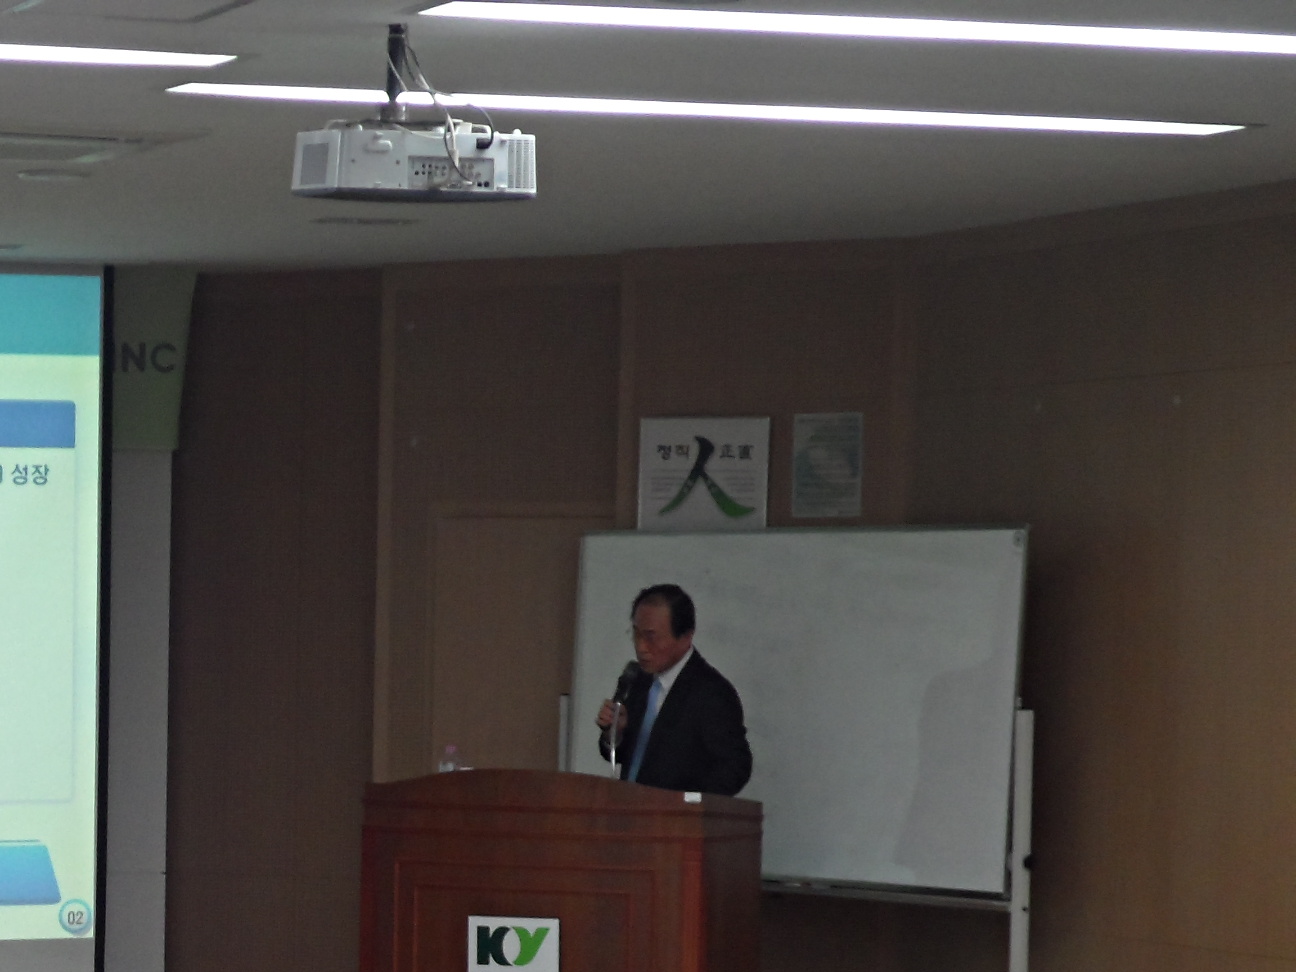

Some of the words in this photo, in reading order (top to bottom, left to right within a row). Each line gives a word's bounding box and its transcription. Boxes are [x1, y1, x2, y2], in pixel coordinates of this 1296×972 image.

[11, 463, 50, 486] 성장
[67, 911, 84, 925] 02
[477, 926, 550, 966] KY
